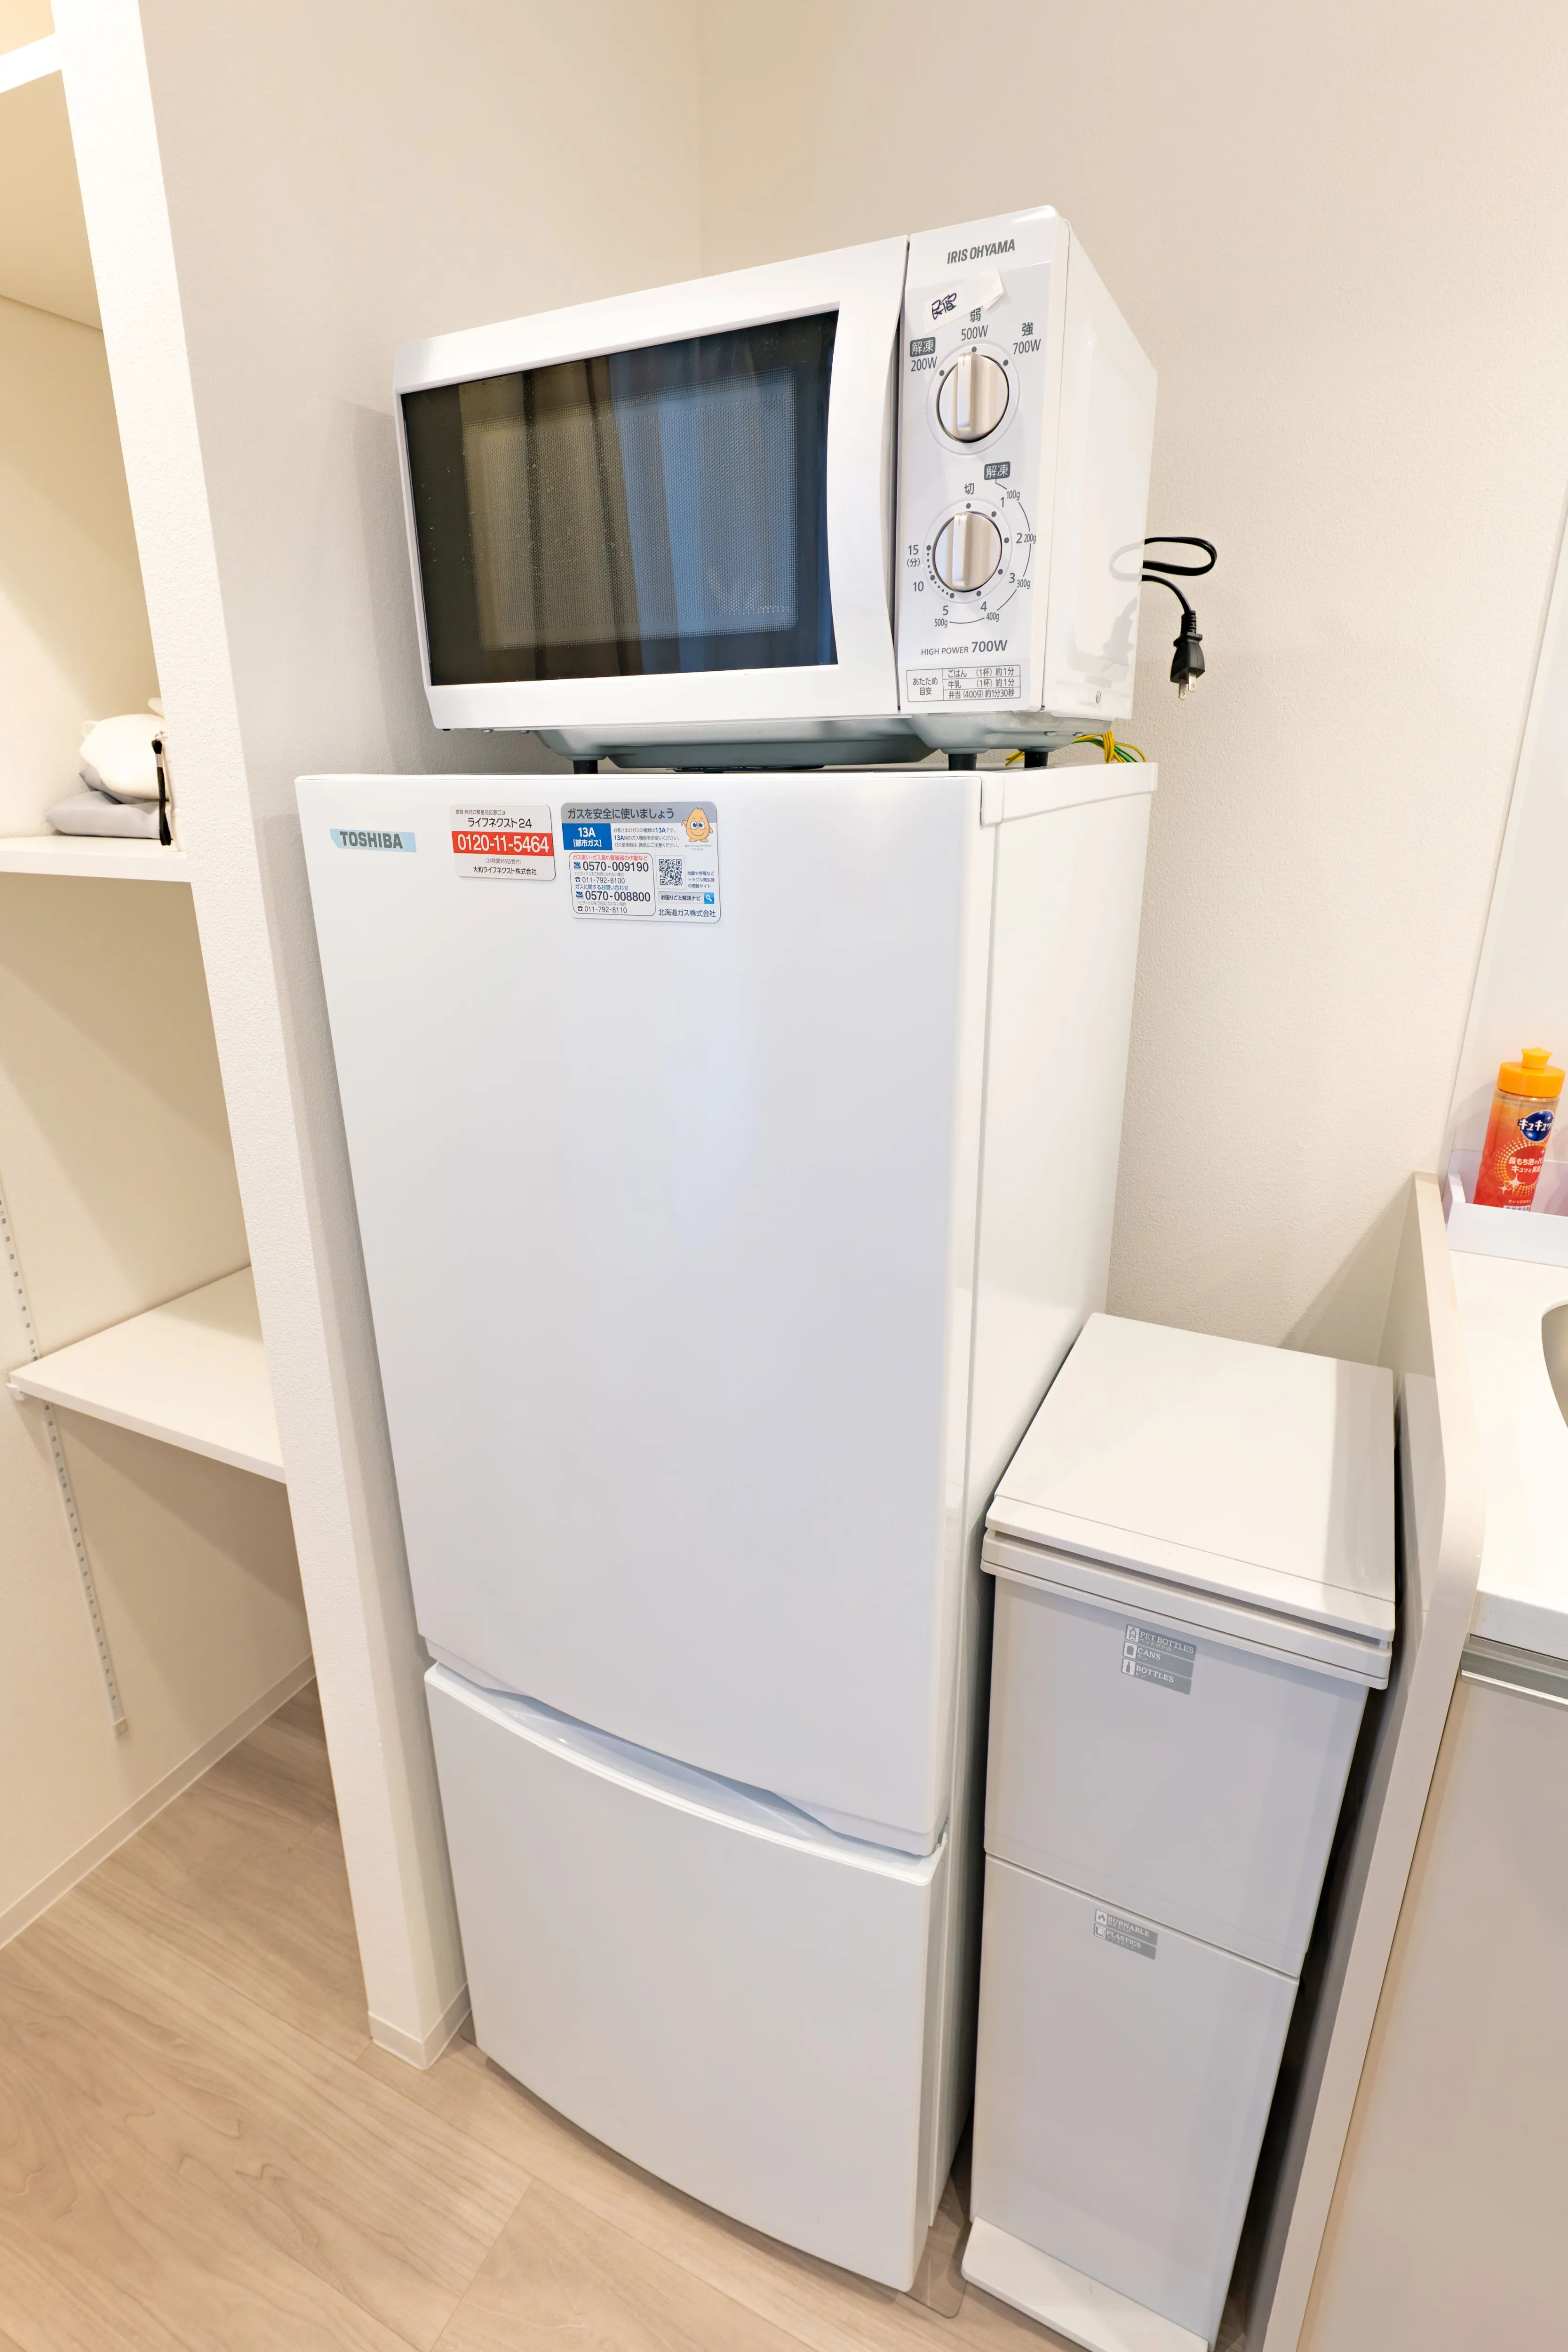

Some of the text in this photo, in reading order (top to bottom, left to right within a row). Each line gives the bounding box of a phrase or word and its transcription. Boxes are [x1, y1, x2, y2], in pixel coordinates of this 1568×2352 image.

[947, 239, 1015, 264] IRIS OHYAMA
[970, 308, 981, 322] 弱
[961, 325, 988, 341] 500W
[1021, 322, 1034, 336] 強
[911, 339, 934, 355] 解凍
[1013, 339, 1041, 355] 700W
[911, 357, 937, 372] 200W
[986, 464, 1009, 478] 解凍
[964, 483, 974, 495] 切
[1006, 490, 1020, 501] 100g
[1000, 497, 1005, 508] 1
[1016, 533, 1036, 544] 2 200g
[908, 545, 919, 555] 15
[1009, 573, 1015, 583] 3
[913, 581, 924, 591] 10
[1017, 579, 1031, 589] 300g
[943, 605, 948, 615] 5
[980, 601, 987, 612] 4
[986, 612, 999, 622] 400g
[934, 619, 948, 628] 500g
[941, 646, 969, 655] POWER
[971, 639, 1008, 653] 700W
[947, 669, 967, 678] ごはん
[913, 677, 938, 686] あたため
[948, 680, 961, 689] 牛乳
[948, 691, 961, 699] 弁当
[567, 808, 674, 820] ガスを安全に使いましょう
[468, 818, 532, 828] ライフネクスト24
[578, 827, 596, 837] 13A
[339, 831, 403, 849] TOSHIBA
[457, 834, 549, 853] 0120-11-5464
[473, 866, 537, 875] 大和ライフネクスト株式会社
[583, 861, 649, 872] 0570-009190
[585, 890, 651, 902] 0570-008800
[658, 908, 716, 917] 北海道ガス株式会社
[1139, 1638, 1172, 1652] ペットボトル
[1140, 1631, 1194, 1653] PET BOTTLES
[1138, 1648, 1161, 1660] CANS
[1136, 1665, 1174, 1683] BOTTLES
[1107, 1916, 1150, 1937] BURNABLE
[1106, 1930, 1141, 1948] PLASTICS
